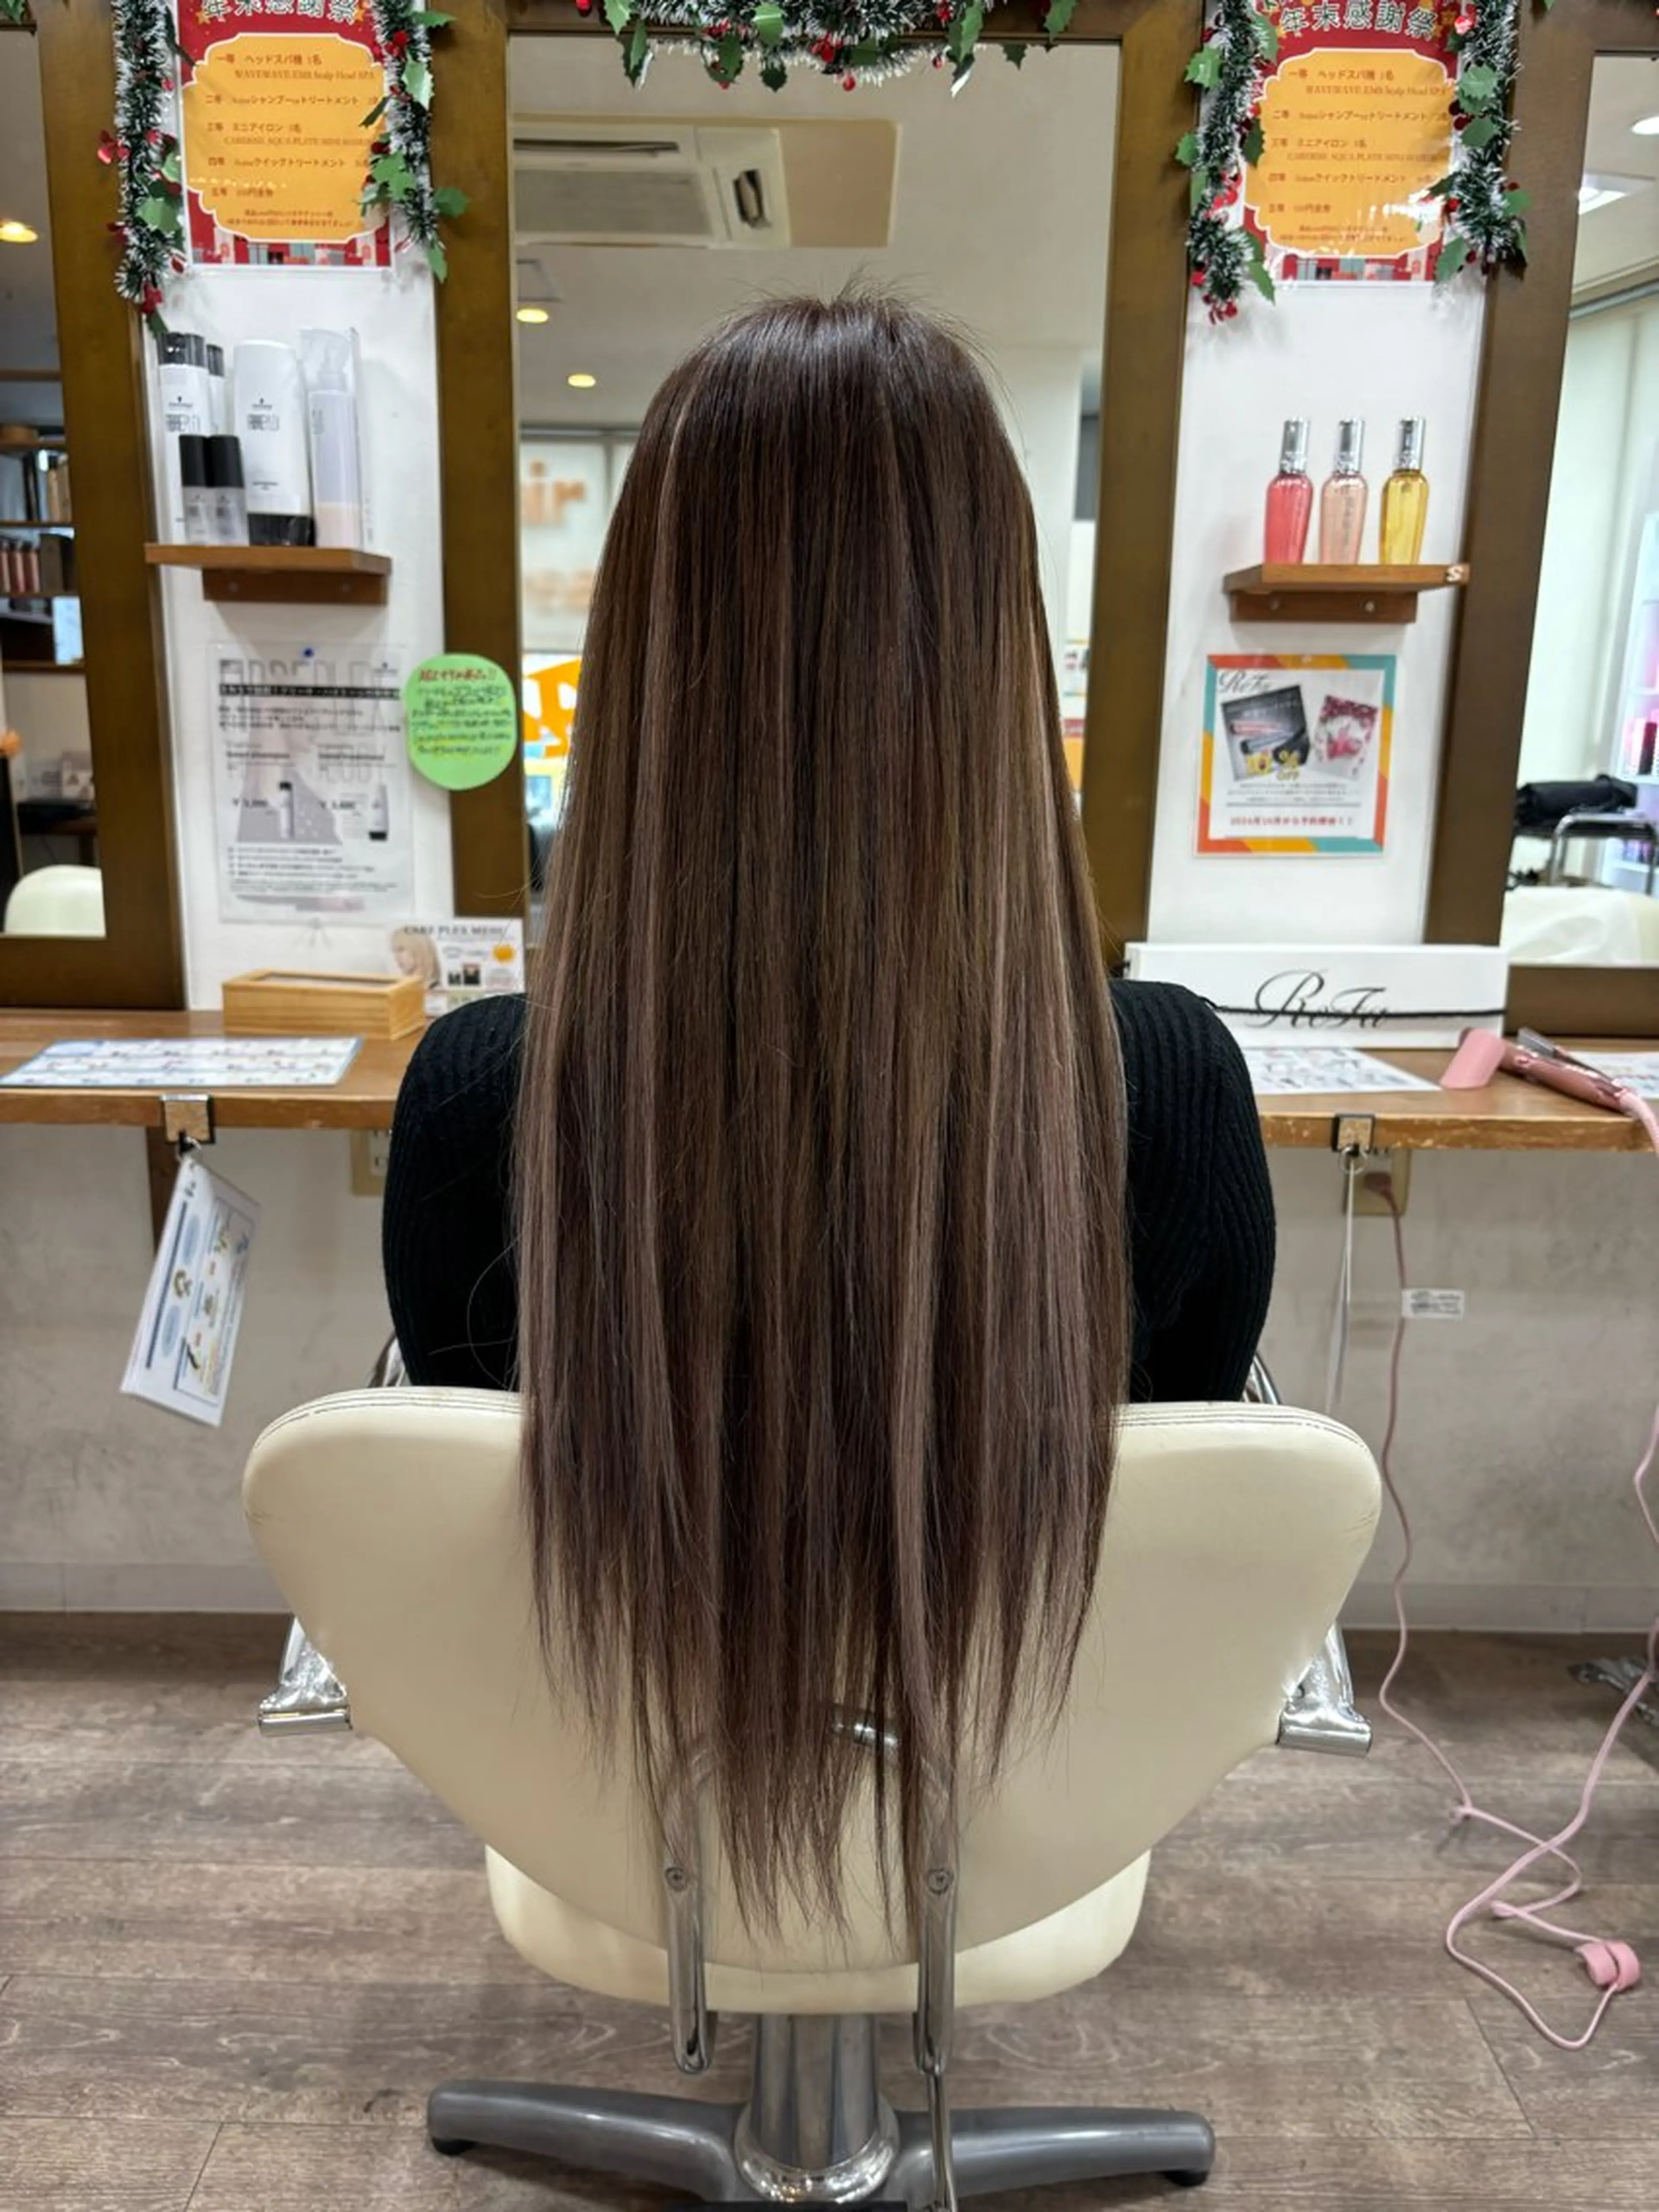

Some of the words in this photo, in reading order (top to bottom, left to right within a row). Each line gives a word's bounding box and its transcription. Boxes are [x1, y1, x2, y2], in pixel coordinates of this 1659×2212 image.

[1281, 0, 1438, 41] 年末感謝祭
